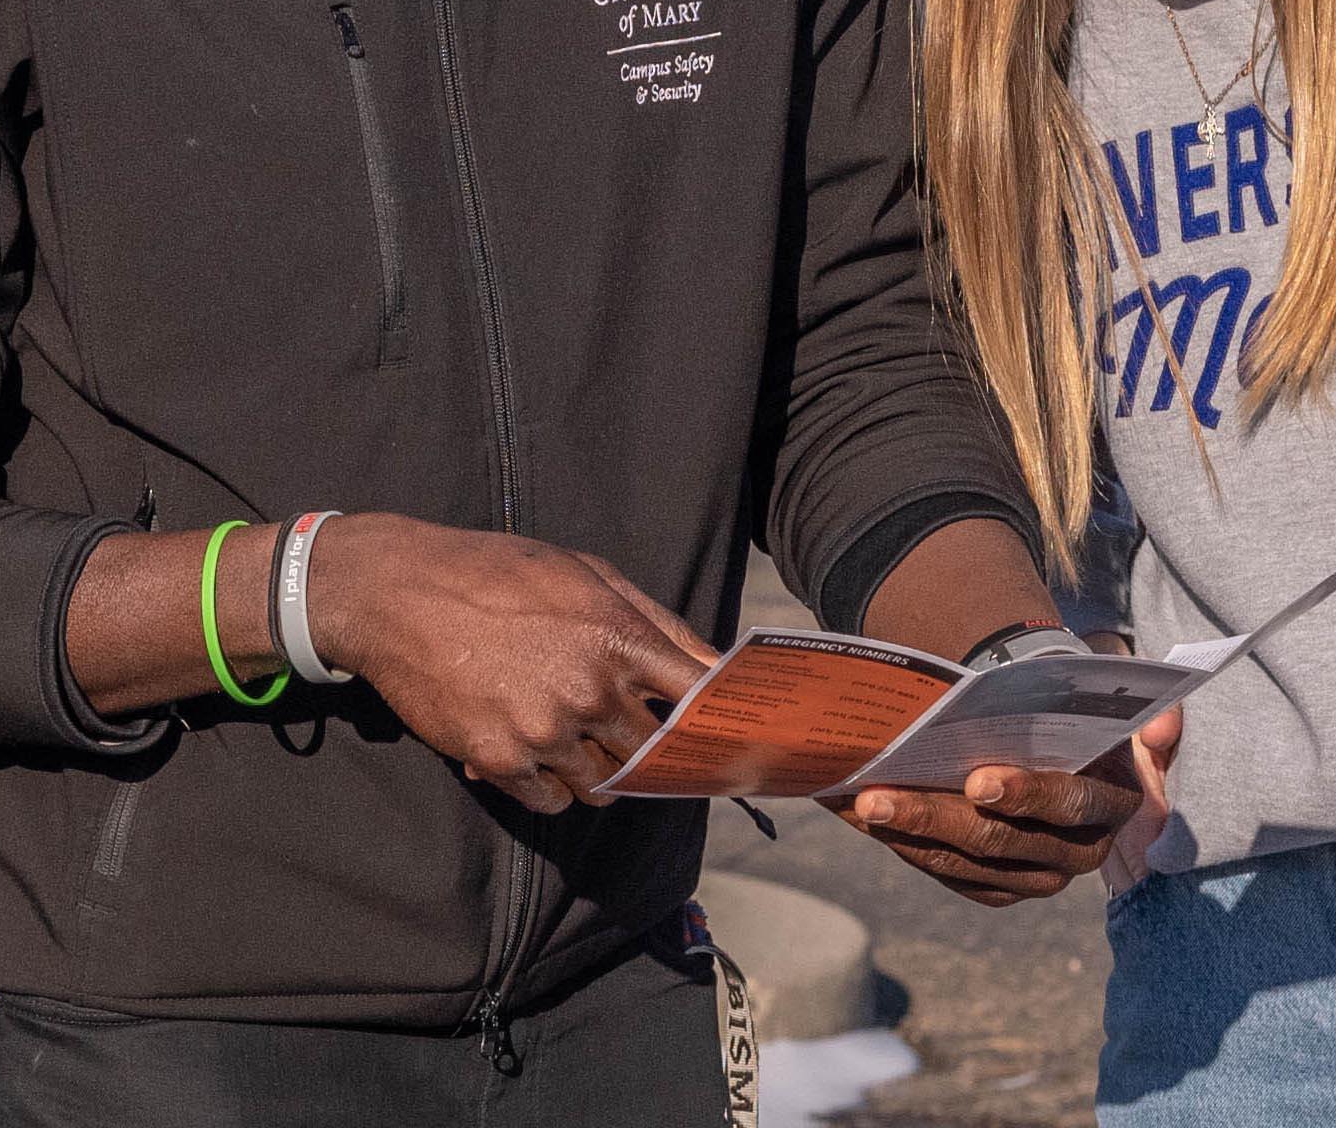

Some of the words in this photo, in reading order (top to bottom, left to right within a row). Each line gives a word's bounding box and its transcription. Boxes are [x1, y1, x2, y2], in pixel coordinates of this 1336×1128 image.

[619, 5, 637, 38] of
[642, 1, 702, 29] MARY
[620, 60, 671, 83] Campus
[674, 51, 714, 76] Safety
[636, 88, 648, 105] &
[651, 80, 701, 103] Security
[289, 534, 305, 556] for
[285, 559, 302, 593] play
[762, 636, 847, 654] EMERGENCY
[847, 646, 911, 666] NUMBERS
[726, 984, 755, 1128] BISM
